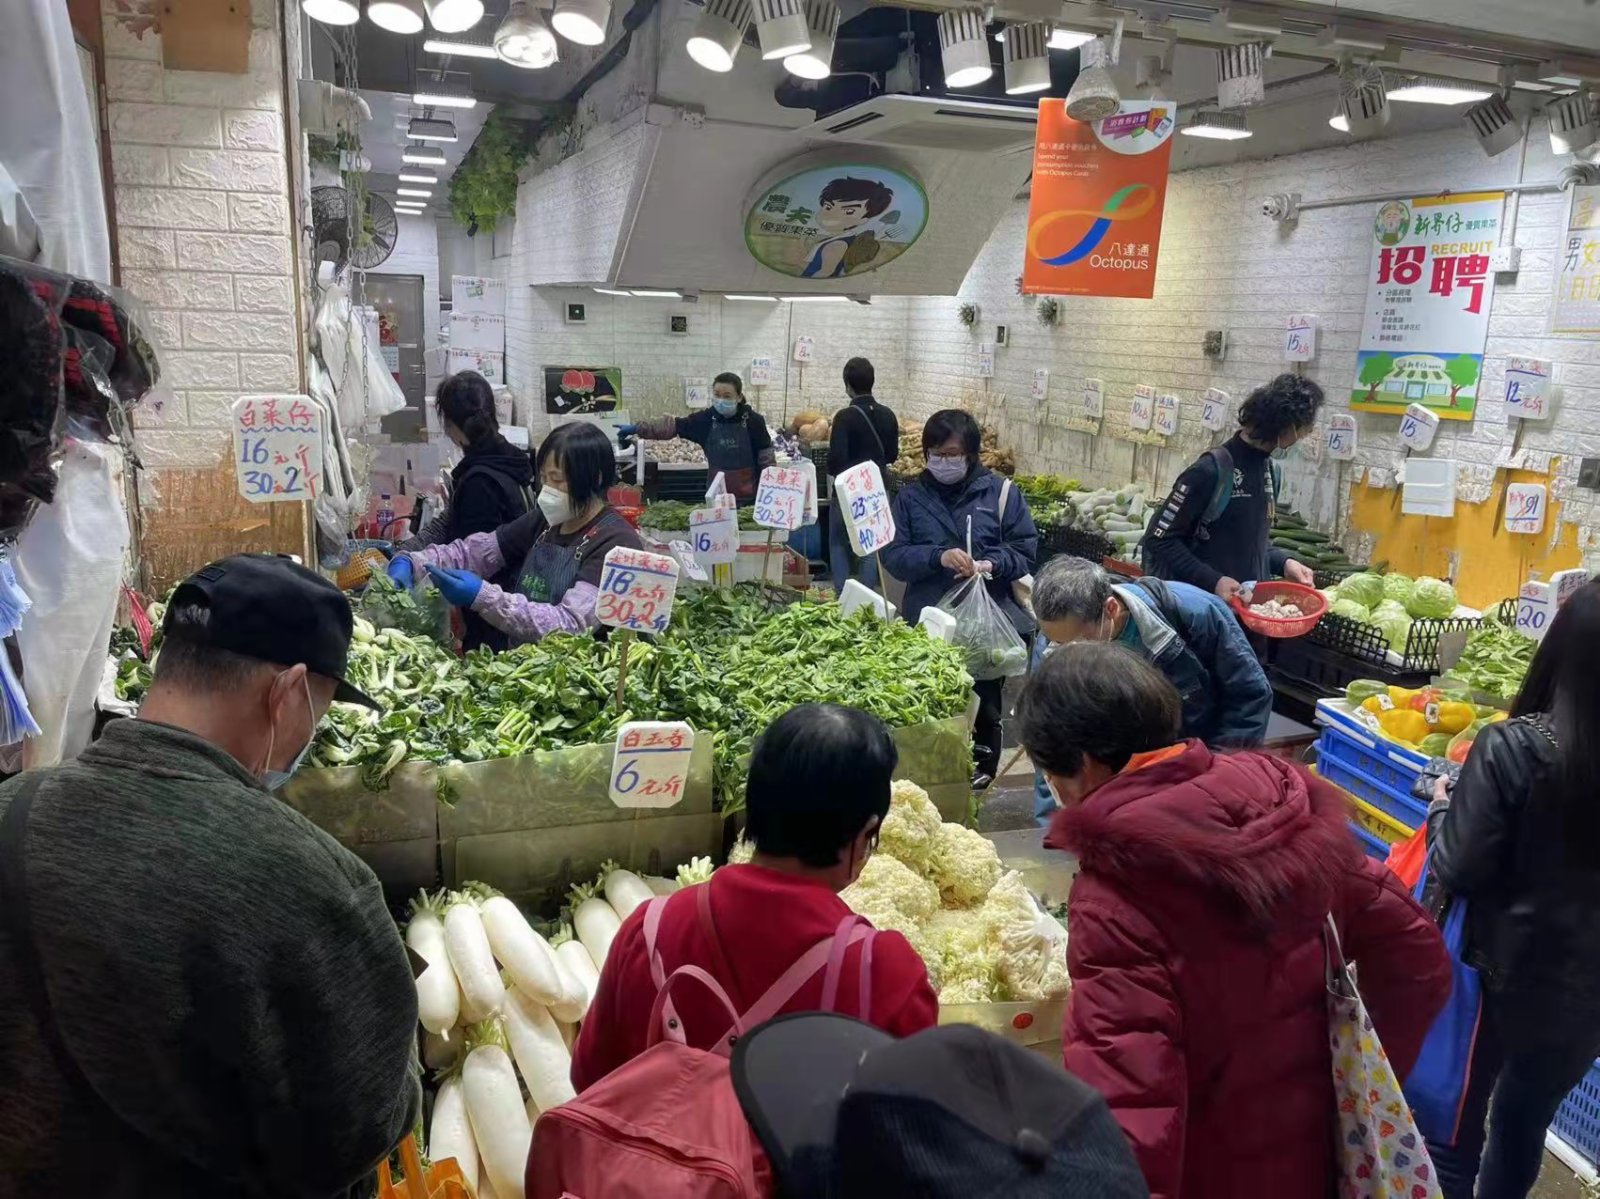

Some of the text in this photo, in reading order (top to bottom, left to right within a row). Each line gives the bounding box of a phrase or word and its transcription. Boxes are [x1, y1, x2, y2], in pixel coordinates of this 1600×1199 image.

[1108, 242, 1150, 257] 八達通
[1431, 240, 1494, 256] RECRUIT
[1090, 254, 1149, 271] Octopus
[1377, 245, 1490, 315] 招聘
[239, 399, 315, 427] 白菜仔
[1517, 605, 1546, 629] 20
